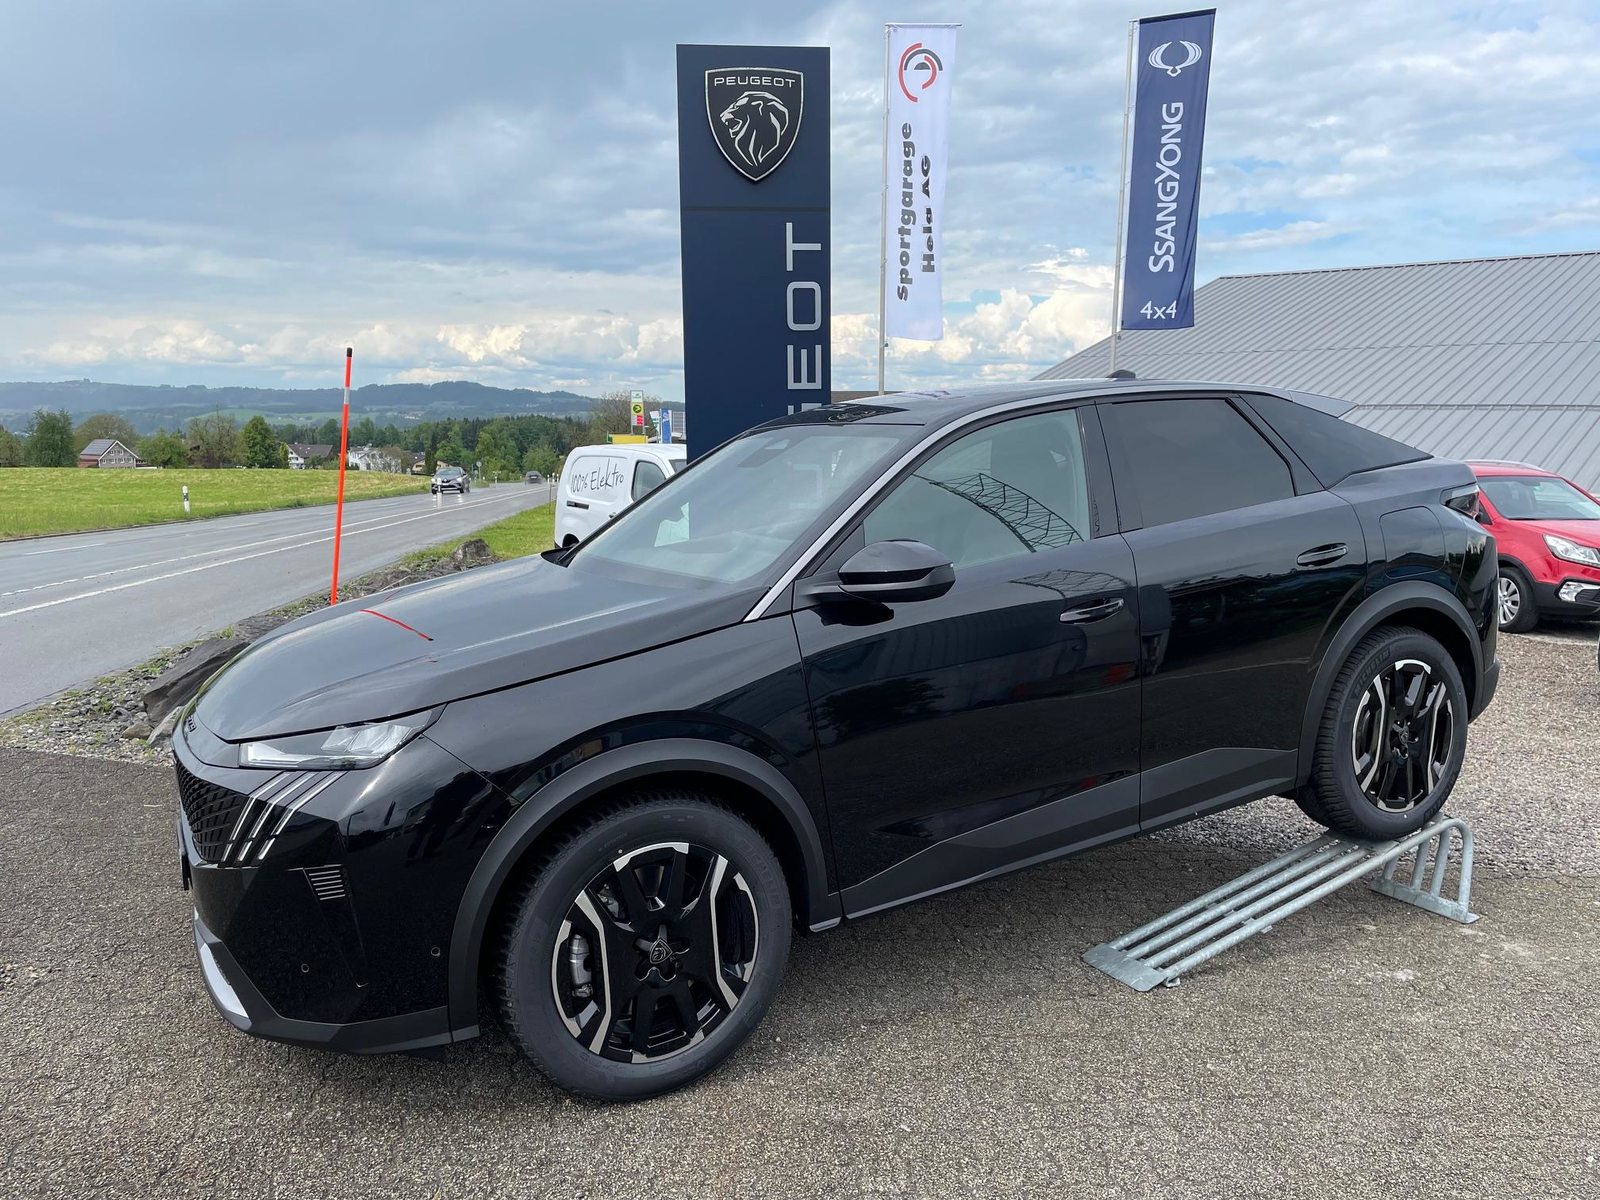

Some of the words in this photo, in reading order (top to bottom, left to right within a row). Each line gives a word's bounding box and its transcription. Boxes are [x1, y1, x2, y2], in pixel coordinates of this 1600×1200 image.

[713, 76, 796, 88] PEUGEOT
[921, 154, 932, 199] AG
[1148, 101, 1184, 273] SSANGYONG
[896, 122, 917, 302] Sportgarage
[785, 222, 822, 415] EOT
[1139, 300, 1177, 320] 4x4
[571, 472, 588, 493] 100%
[591, 459, 625, 491] Elektro
